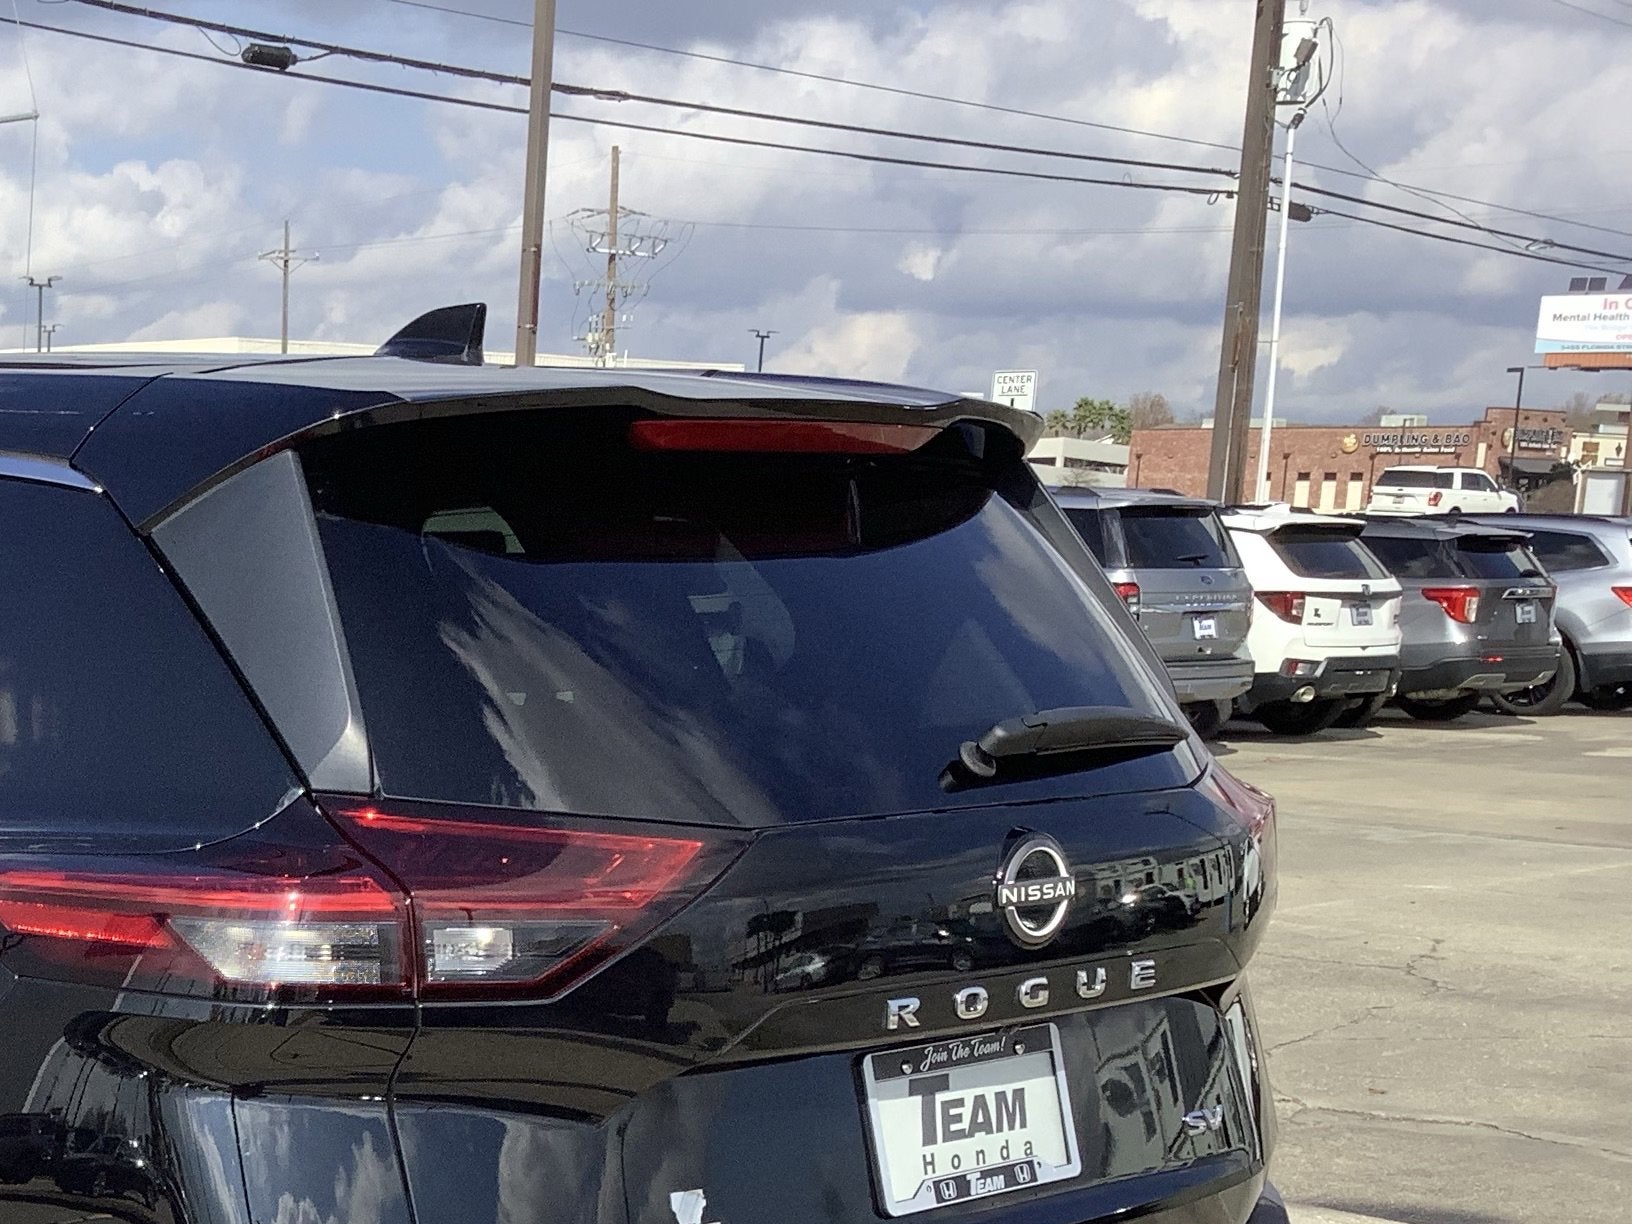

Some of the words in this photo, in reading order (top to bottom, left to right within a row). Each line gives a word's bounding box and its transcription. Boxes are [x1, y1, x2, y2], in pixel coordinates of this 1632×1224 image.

[1602, 298, 1619, 310] In
[1552, 313, 1591, 322] Mental
[1593, 313, 1631, 321] Health
[997, 375, 1033, 384] CENTER
[1001, 385, 1026, 394] LANE
[1444, 434, 1472, 446] BAO
[1002, 878, 1076, 904] NISSAN
[886, 958, 1158, 1030] ROGUE
[920, 1047, 948, 1071] Join
[948, 1037, 971, 1062] The
[1181, 1104, 1224, 1137] SV
[922, 1140, 1034, 1176] Honda
